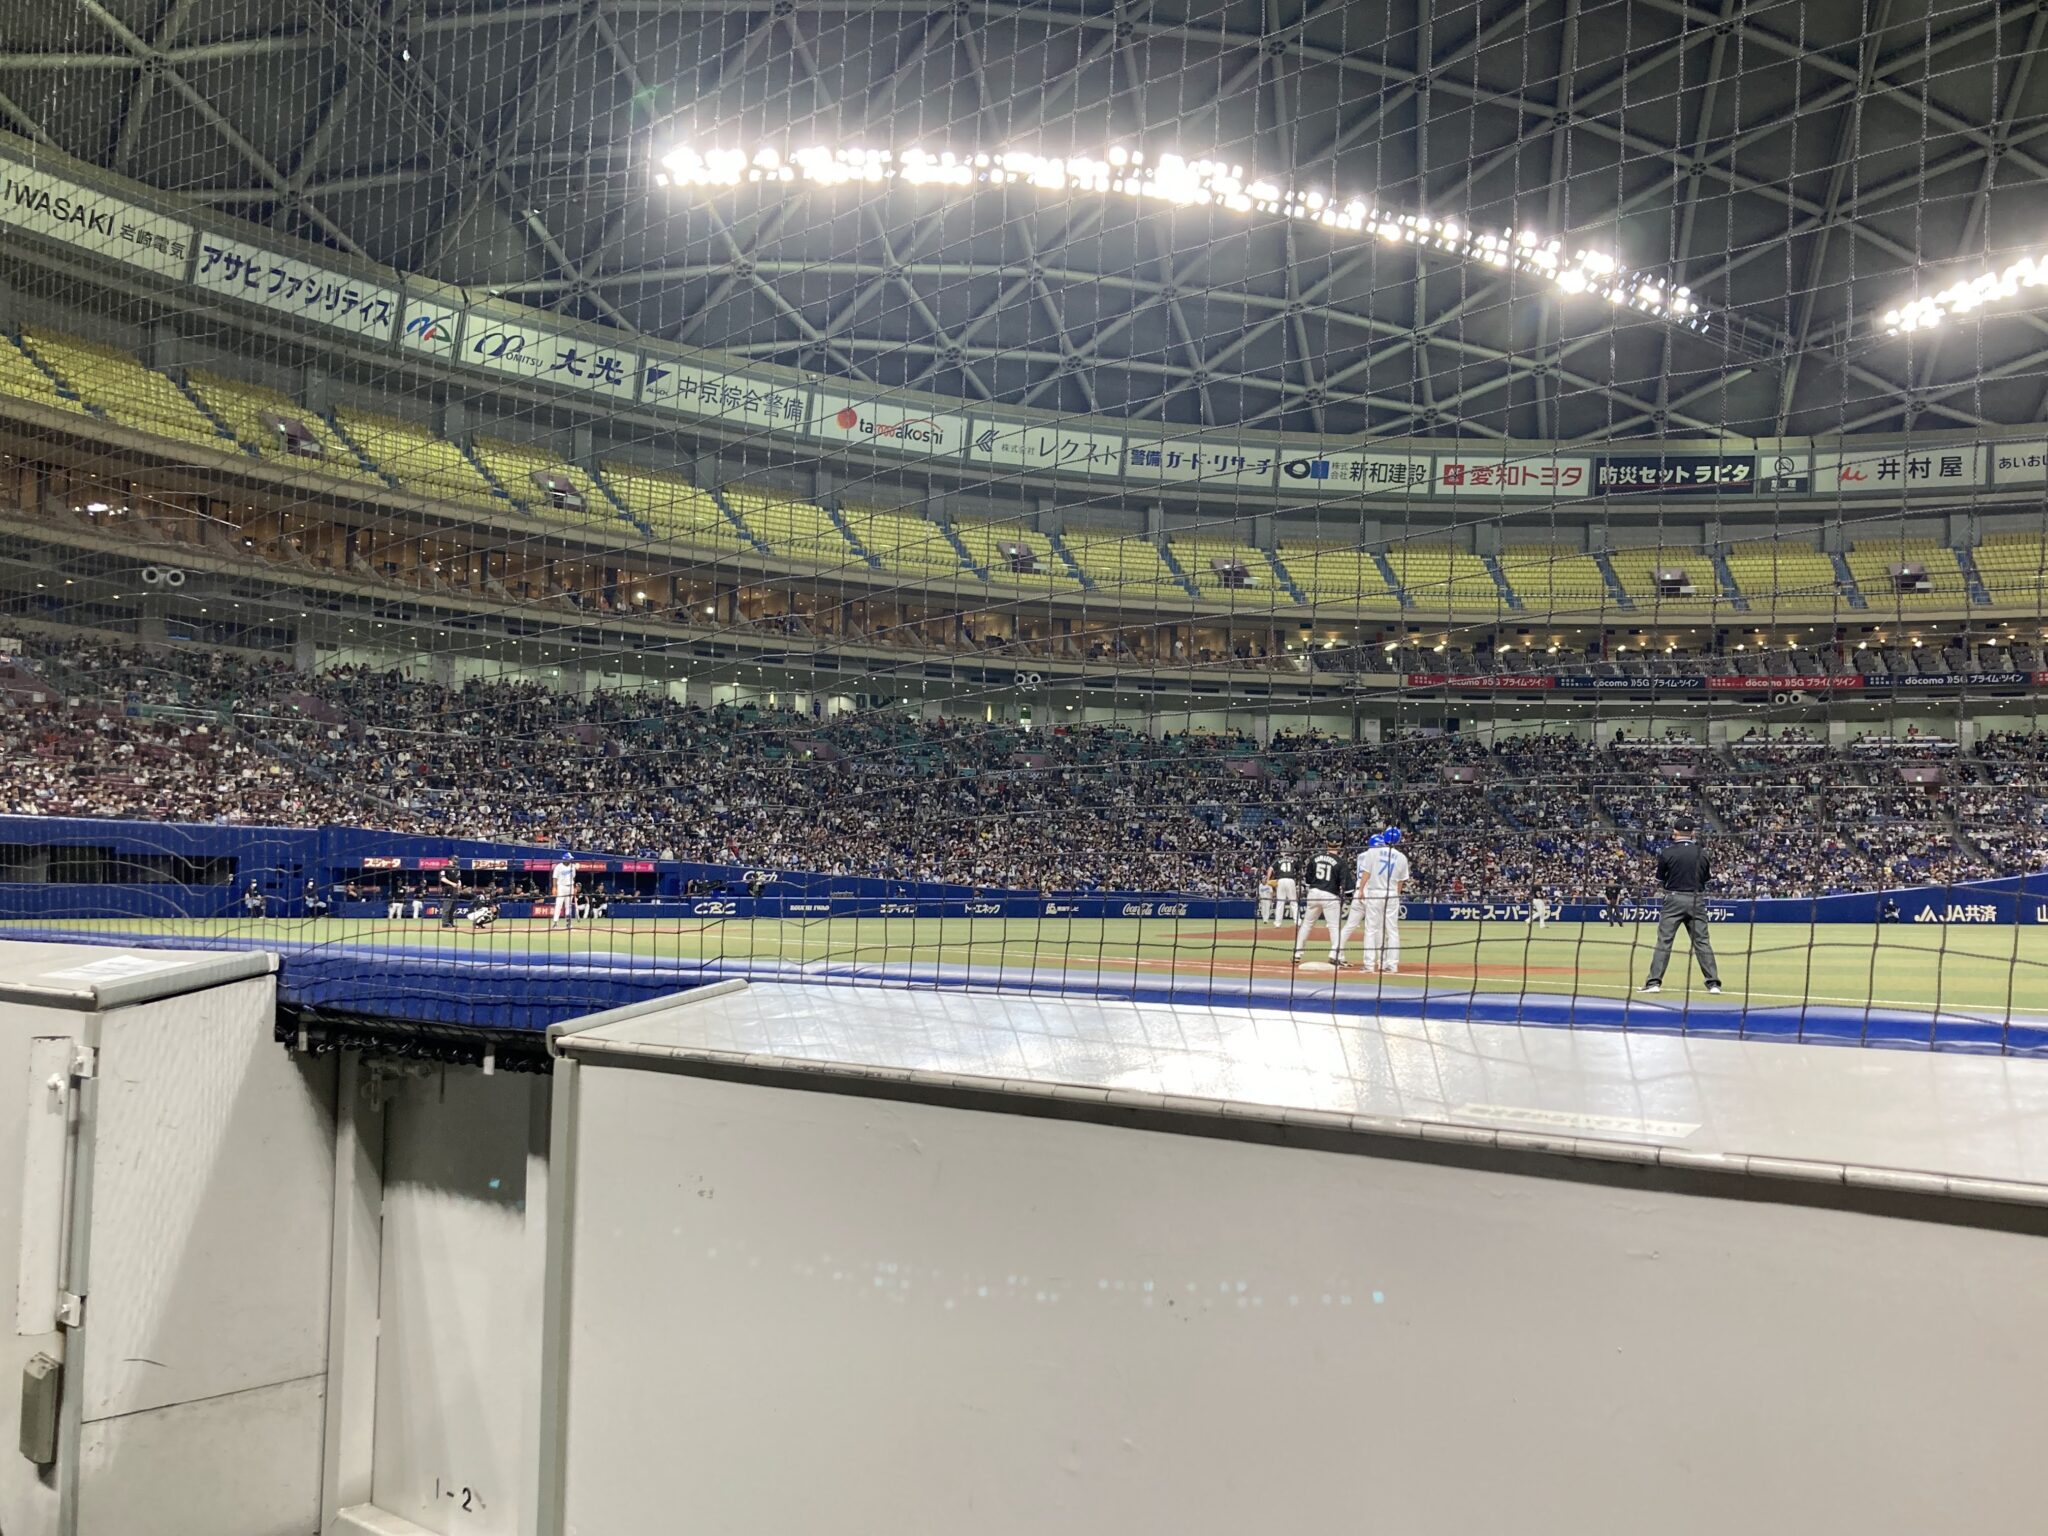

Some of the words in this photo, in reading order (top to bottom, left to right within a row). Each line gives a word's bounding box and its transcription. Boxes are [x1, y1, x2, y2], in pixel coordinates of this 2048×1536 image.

[4, 179, 115, 236] IWASAKI
[120, 224, 186, 260] 岩崎電気
[550, 348, 623, 385] 大光
[679, 376, 804, 421] 中京綜合警備
[860, 418, 943, 445] tamakoshi
[1039, 436, 1117, 465] レクスト
[1349, 461, 1426, 485] 新和建設
[1470, 465, 1582, 487] 愛知トヨタ
[1878, 456, 1963, 480] 井村屋
[1316, 863, 1332, 881] 51
[694, 902, 737, 915] CBC
[965, 904, 1000, 914] トーエネック
